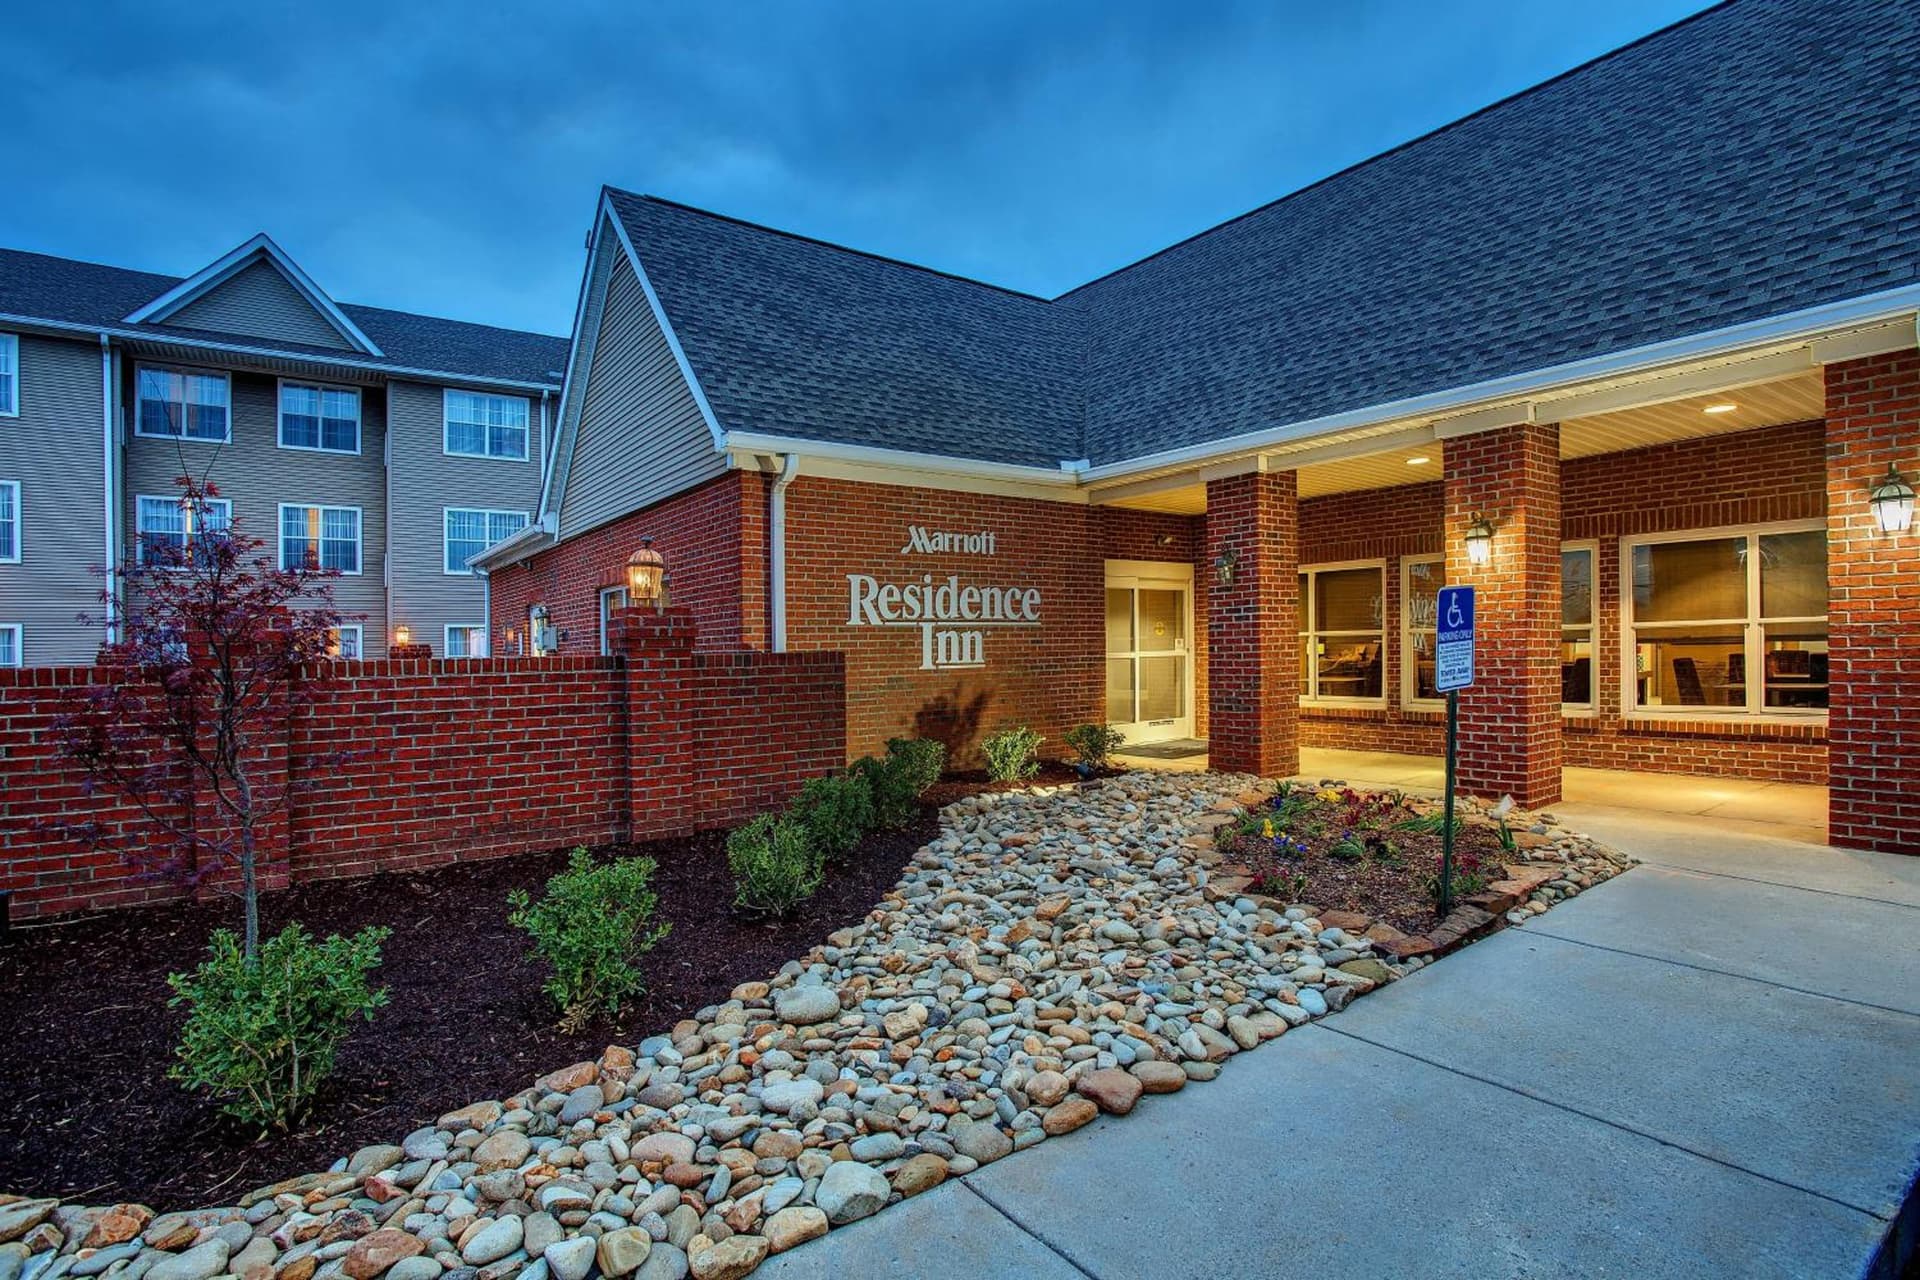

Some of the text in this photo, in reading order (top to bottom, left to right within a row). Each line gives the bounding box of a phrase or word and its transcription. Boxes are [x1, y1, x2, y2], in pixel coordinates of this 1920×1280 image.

[901, 525, 996, 555] Marriott
[846, 574, 1042, 625] Residence
[918, 622, 986, 670] Inn
[1459, 630, 1472, 639] ONLY
